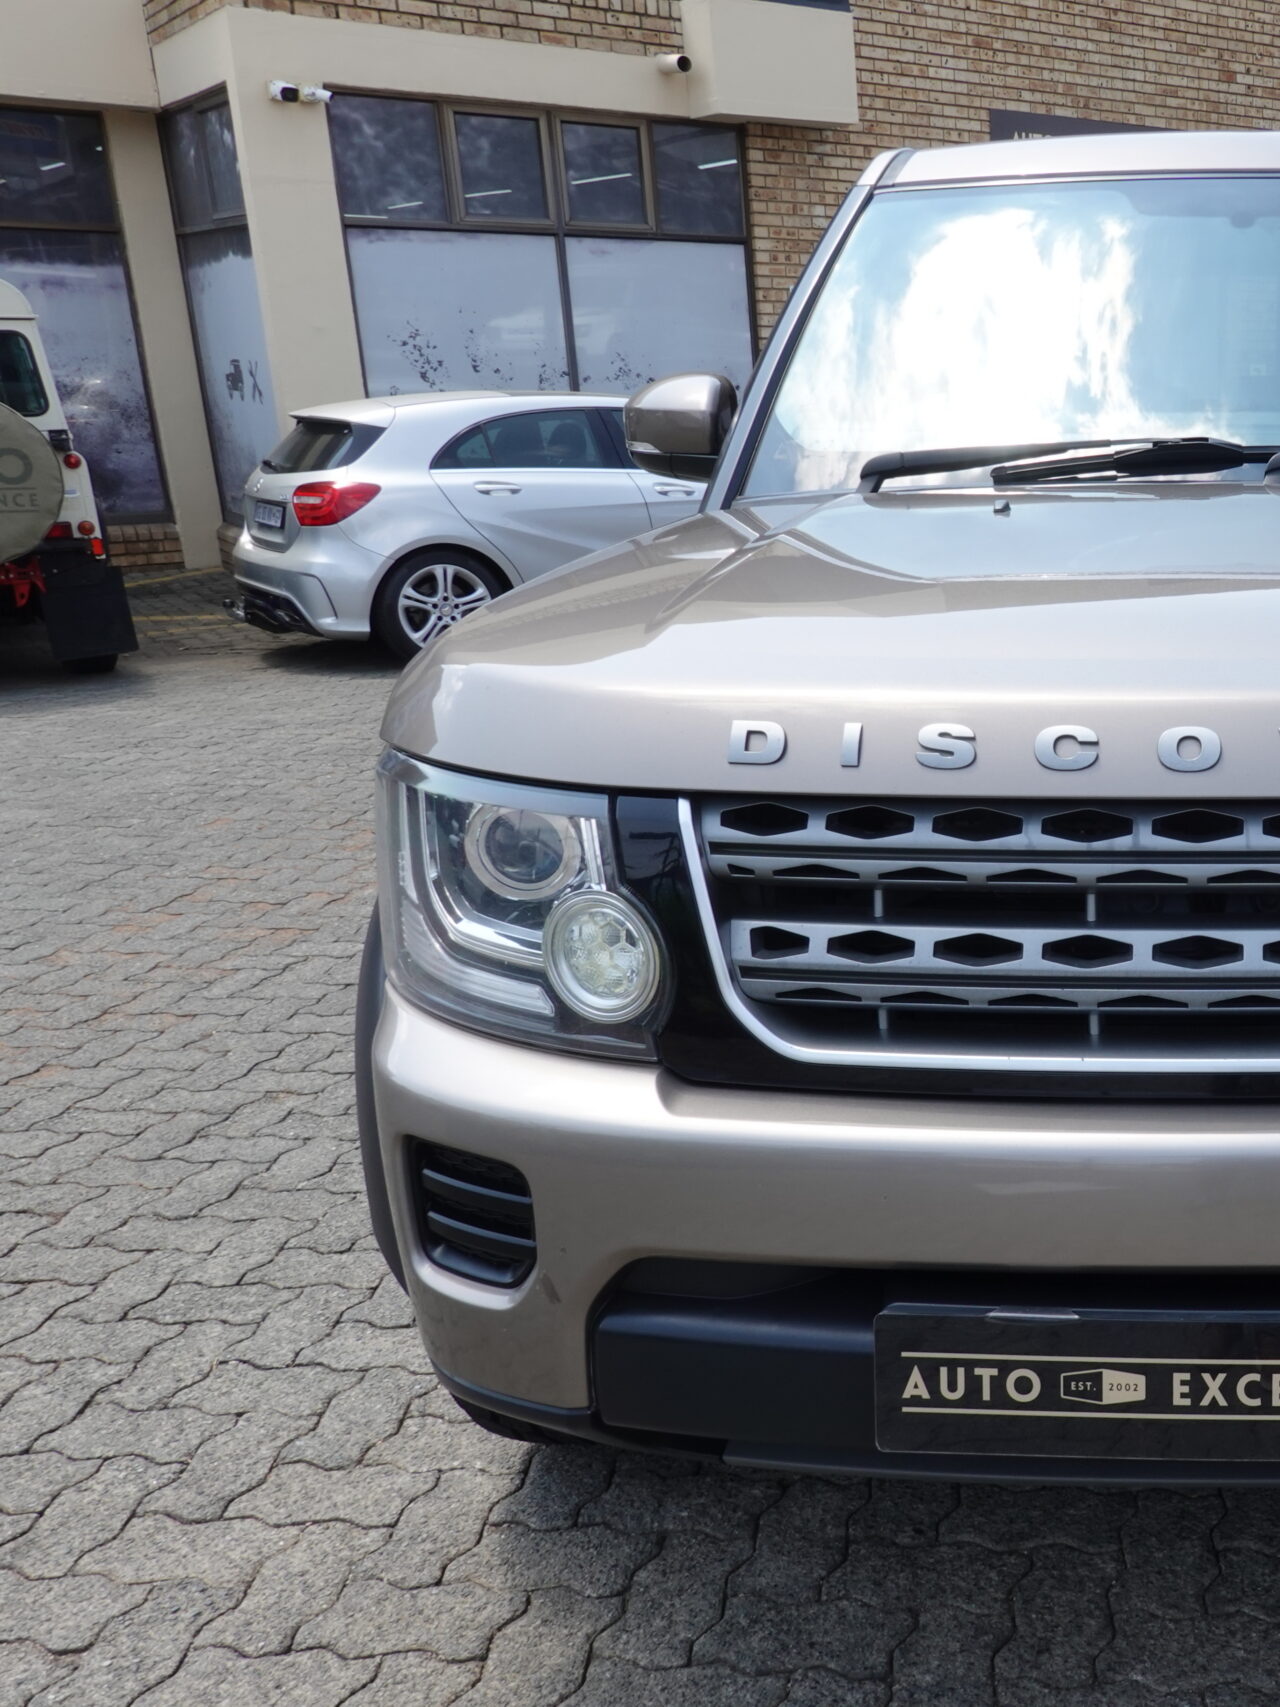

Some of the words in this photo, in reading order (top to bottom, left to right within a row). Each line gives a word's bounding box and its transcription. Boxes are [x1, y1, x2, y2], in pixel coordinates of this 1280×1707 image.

[901, 1364, 1042, 1403] AUTO
[1070, 1381, 1097, 1392] EST.
[1108, 1382, 1139, 1392] 2002
